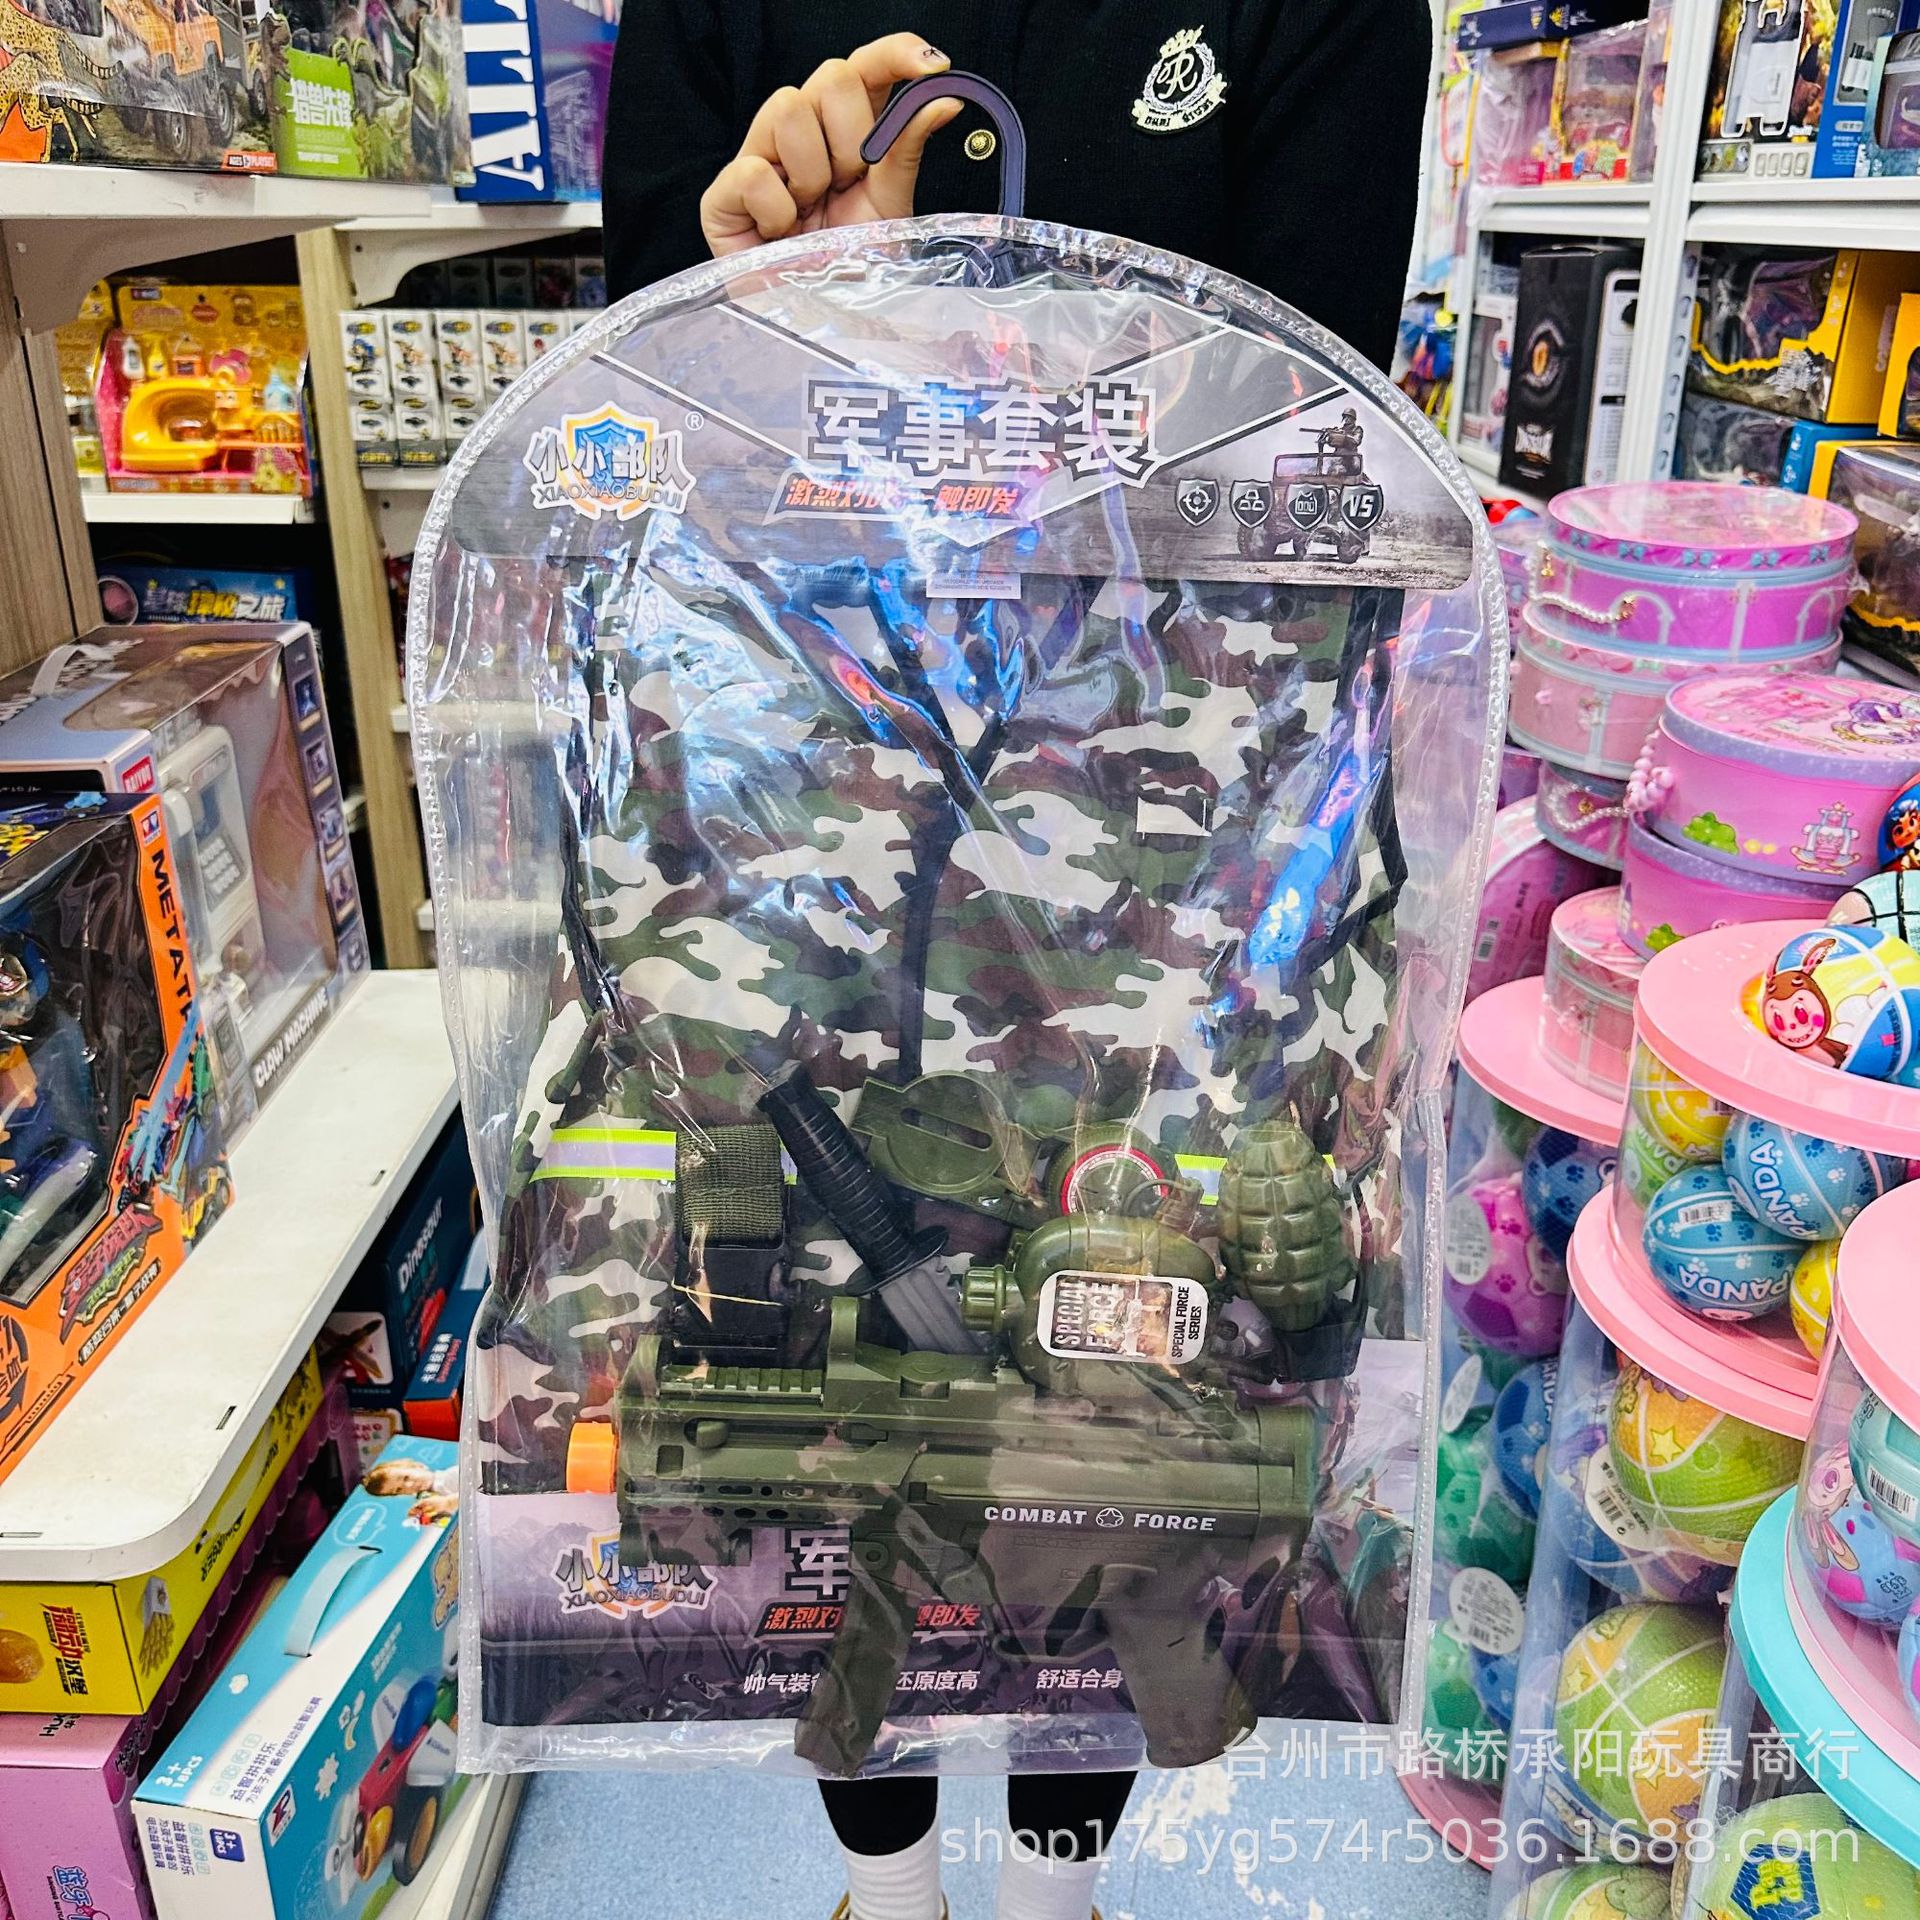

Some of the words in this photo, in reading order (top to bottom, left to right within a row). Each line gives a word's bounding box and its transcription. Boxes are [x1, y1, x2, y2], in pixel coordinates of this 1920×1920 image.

[813, 383, 1147, 474] 军事套装
[529, 432, 691, 491] 小小部队
[536, 482, 682, 509] XIAOXIAOBUDUI
[1349, 494, 1374, 518] VS
[255, 1038, 288, 1088] CLAW
[284, 987, 328, 1048] MACHINE
[1750, 1139, 1820, 1240] PANDA
[1678, 1264, 1790, 1301] PANDA
[1176, 1286, 1190, 1318] FORCE
[1172, 1317, 1188, 1358] SPECIAL
[1188, 1305, 1202, 1340] SERIES
[984, 1506, 1088, 1525] COMBAT
[1133, 1513, 1217, 1532] FORCE
[564, 1586, 706, 1608] XIAOXIAOBUDUI
[1036, 1667, 1124, 1690] 舒适合身
[230, 1742, 277, 1802] 益智拼拼乐
[172, 1821, 195, 1876] 益智拼拼乐
